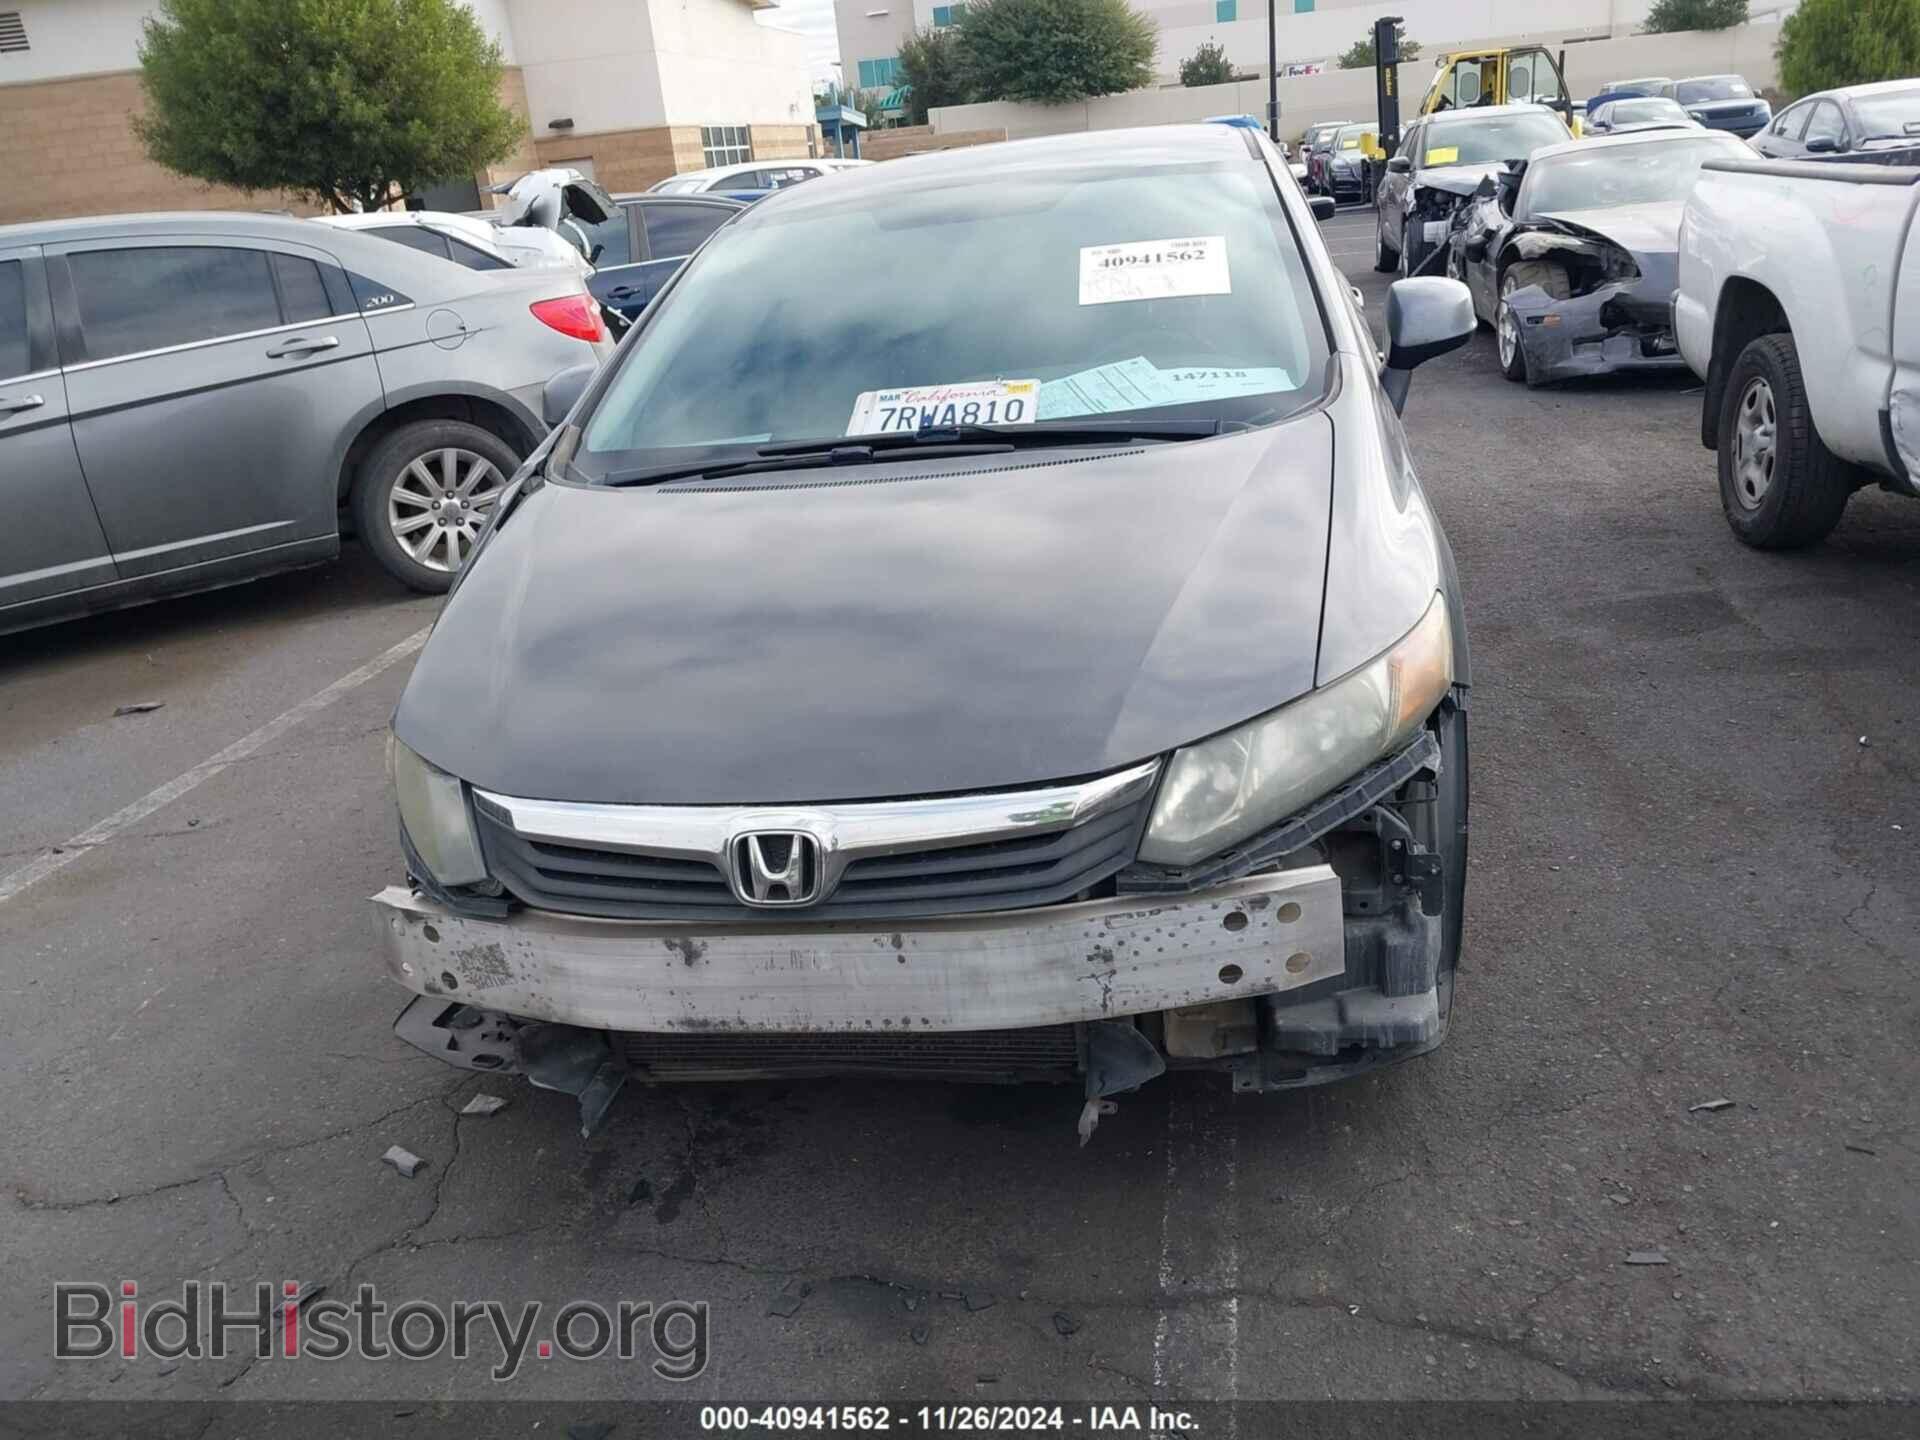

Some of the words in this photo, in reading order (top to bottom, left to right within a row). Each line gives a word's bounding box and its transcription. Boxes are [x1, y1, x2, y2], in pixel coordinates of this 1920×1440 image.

[1098, 249, 1206, 268] 40941562
[366, 294, 394, 308] 200
[903, 387, 1001, 403] California
[879, 399, 1025, 432] 7RWA810
